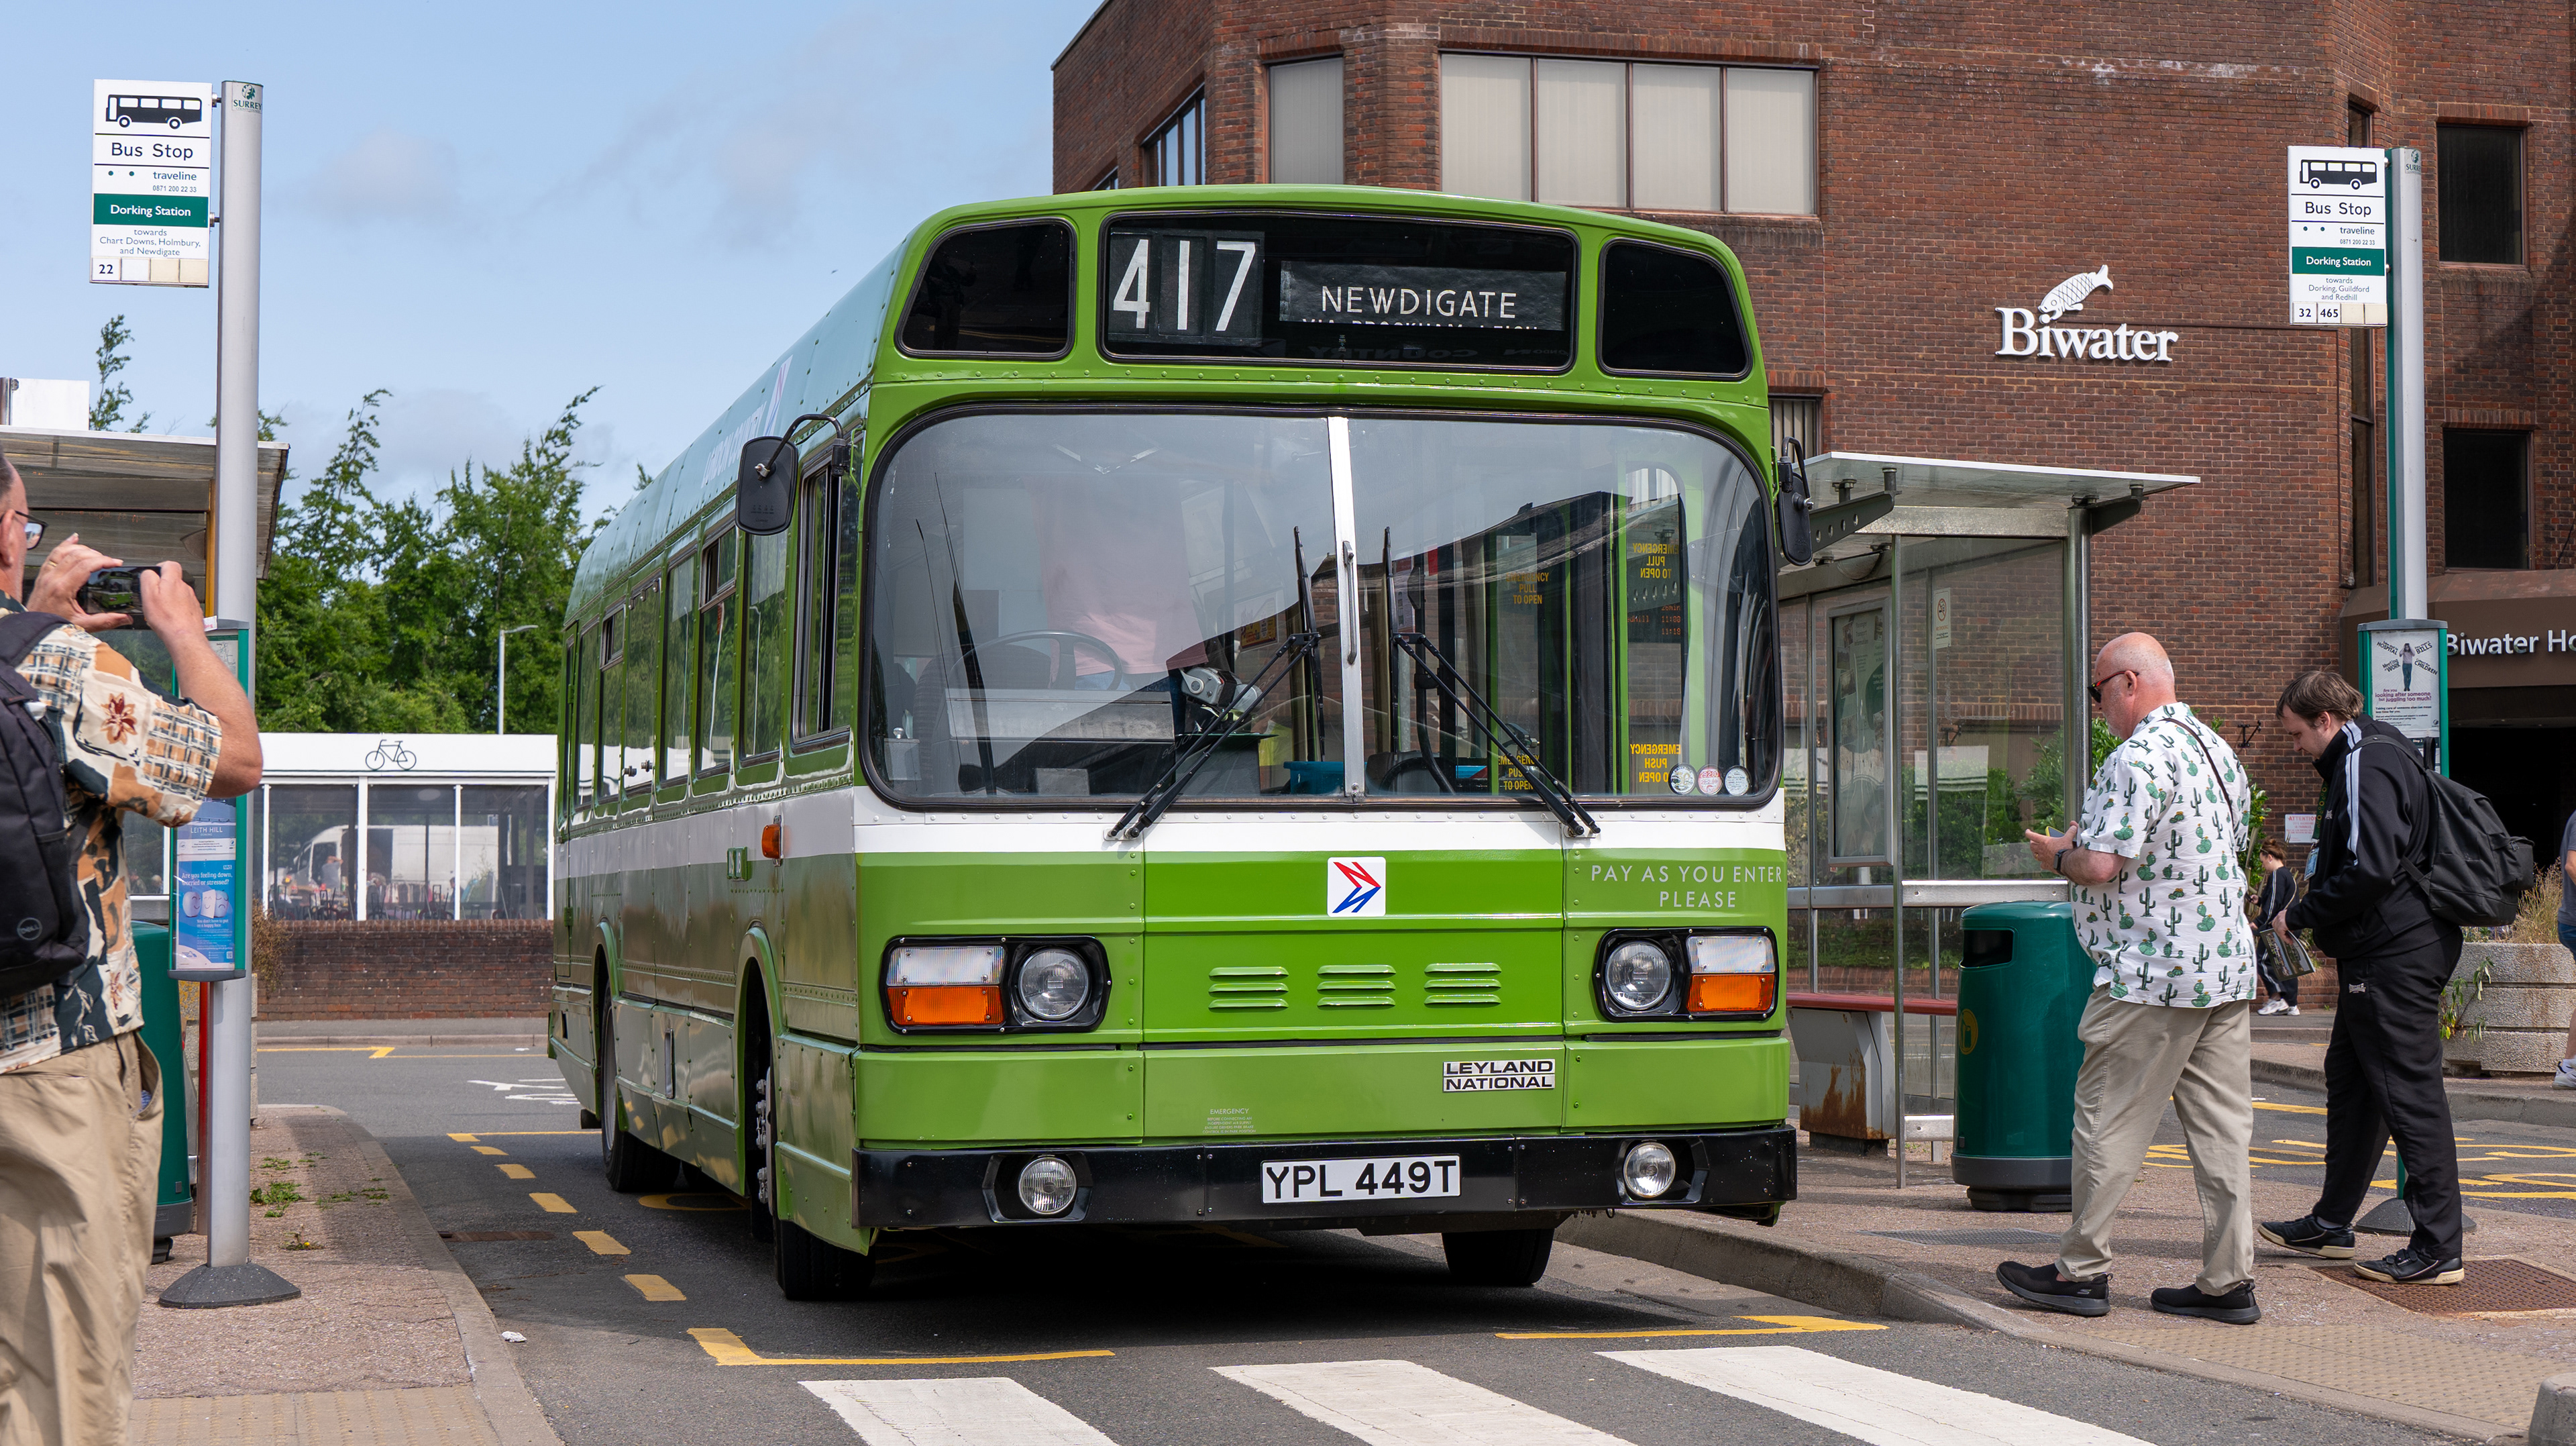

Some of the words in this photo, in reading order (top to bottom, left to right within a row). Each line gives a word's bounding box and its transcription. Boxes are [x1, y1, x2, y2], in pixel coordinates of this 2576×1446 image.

[233, 99, 262, 110] SURREY
[111, 142, 143, 157] Bus
[152, 144, 193, 161] Stop
[152, 171, 197, 180] traveline
[110, 204, 153, 217] Dorking
[155, 205, 192, 217] Station
[2305, 201, 2332, 214] Bus
[2339, 202, 2371, 217] Stop
[2339, 226, 2375, 235] traveline
[99, 236, 123, 244] Chart
[125, 237, 157, 246] Downs,
[158, 238, 201, 248] Holmbury,
[137, 247, 180, 257] Newdigate
[2306, 256, 2341, 268] Dorking
[2342, 257, 2371, 266] Station
[99, 264, 114, 274] 22
[1112, 238, 1257, 332] 417
[2308, 285, 2337, 293] Dorking,
[2339, 285, 2370, 293] Guildford
[1322, 285, 1517, 319] NEWDIGATE
[2299, 308, 2312, 317] 32
[2320, 309, 2339, 318] 465
[1994, 307, 2179, 362] Biwater
[1505, 572, 1550, 582] EMERGENCY
[1519, 584, 1537, 593] PULL
[1513, 595, 1522, 604] TO
[1523, 595, 1542, 604] OPEN
[1627, 615, 1650, 623] edhill
[2376, 641, 2398, 656] HOSPITAL
[2416, 643, 2432, 654] BILLS
[2447, 632, 2539, 656] Biwater
[2382, 659, 2399, 668] Meeting
[2386, 662, 2401, 672] WORK
[2414, 661, 2438, 675] CHILDREN
[1498, 755, 1540, 765] EMEGENY
[1508, 768, 1525, 778] PUS
[1503, 780, 1513, 790] TO
[1514, 780, 1534, 790] OPEN
[1591, 865, 1633, 882] PAY
[1641, 866, 1669, 882] AS
[1678, 866, 1724, 883] YOU
[1733, 866, 1782, 882] ENTER
[1660, 891, 1736, 908] PLEASE
[1446, 1060, 1554, 1075] LEYLAND
[1446, 1076, 1553, 1090] NATIONAL
[1266, 1163, 1343, 1199] YPL
[1354, 1159, 1457, 1196] 449T
